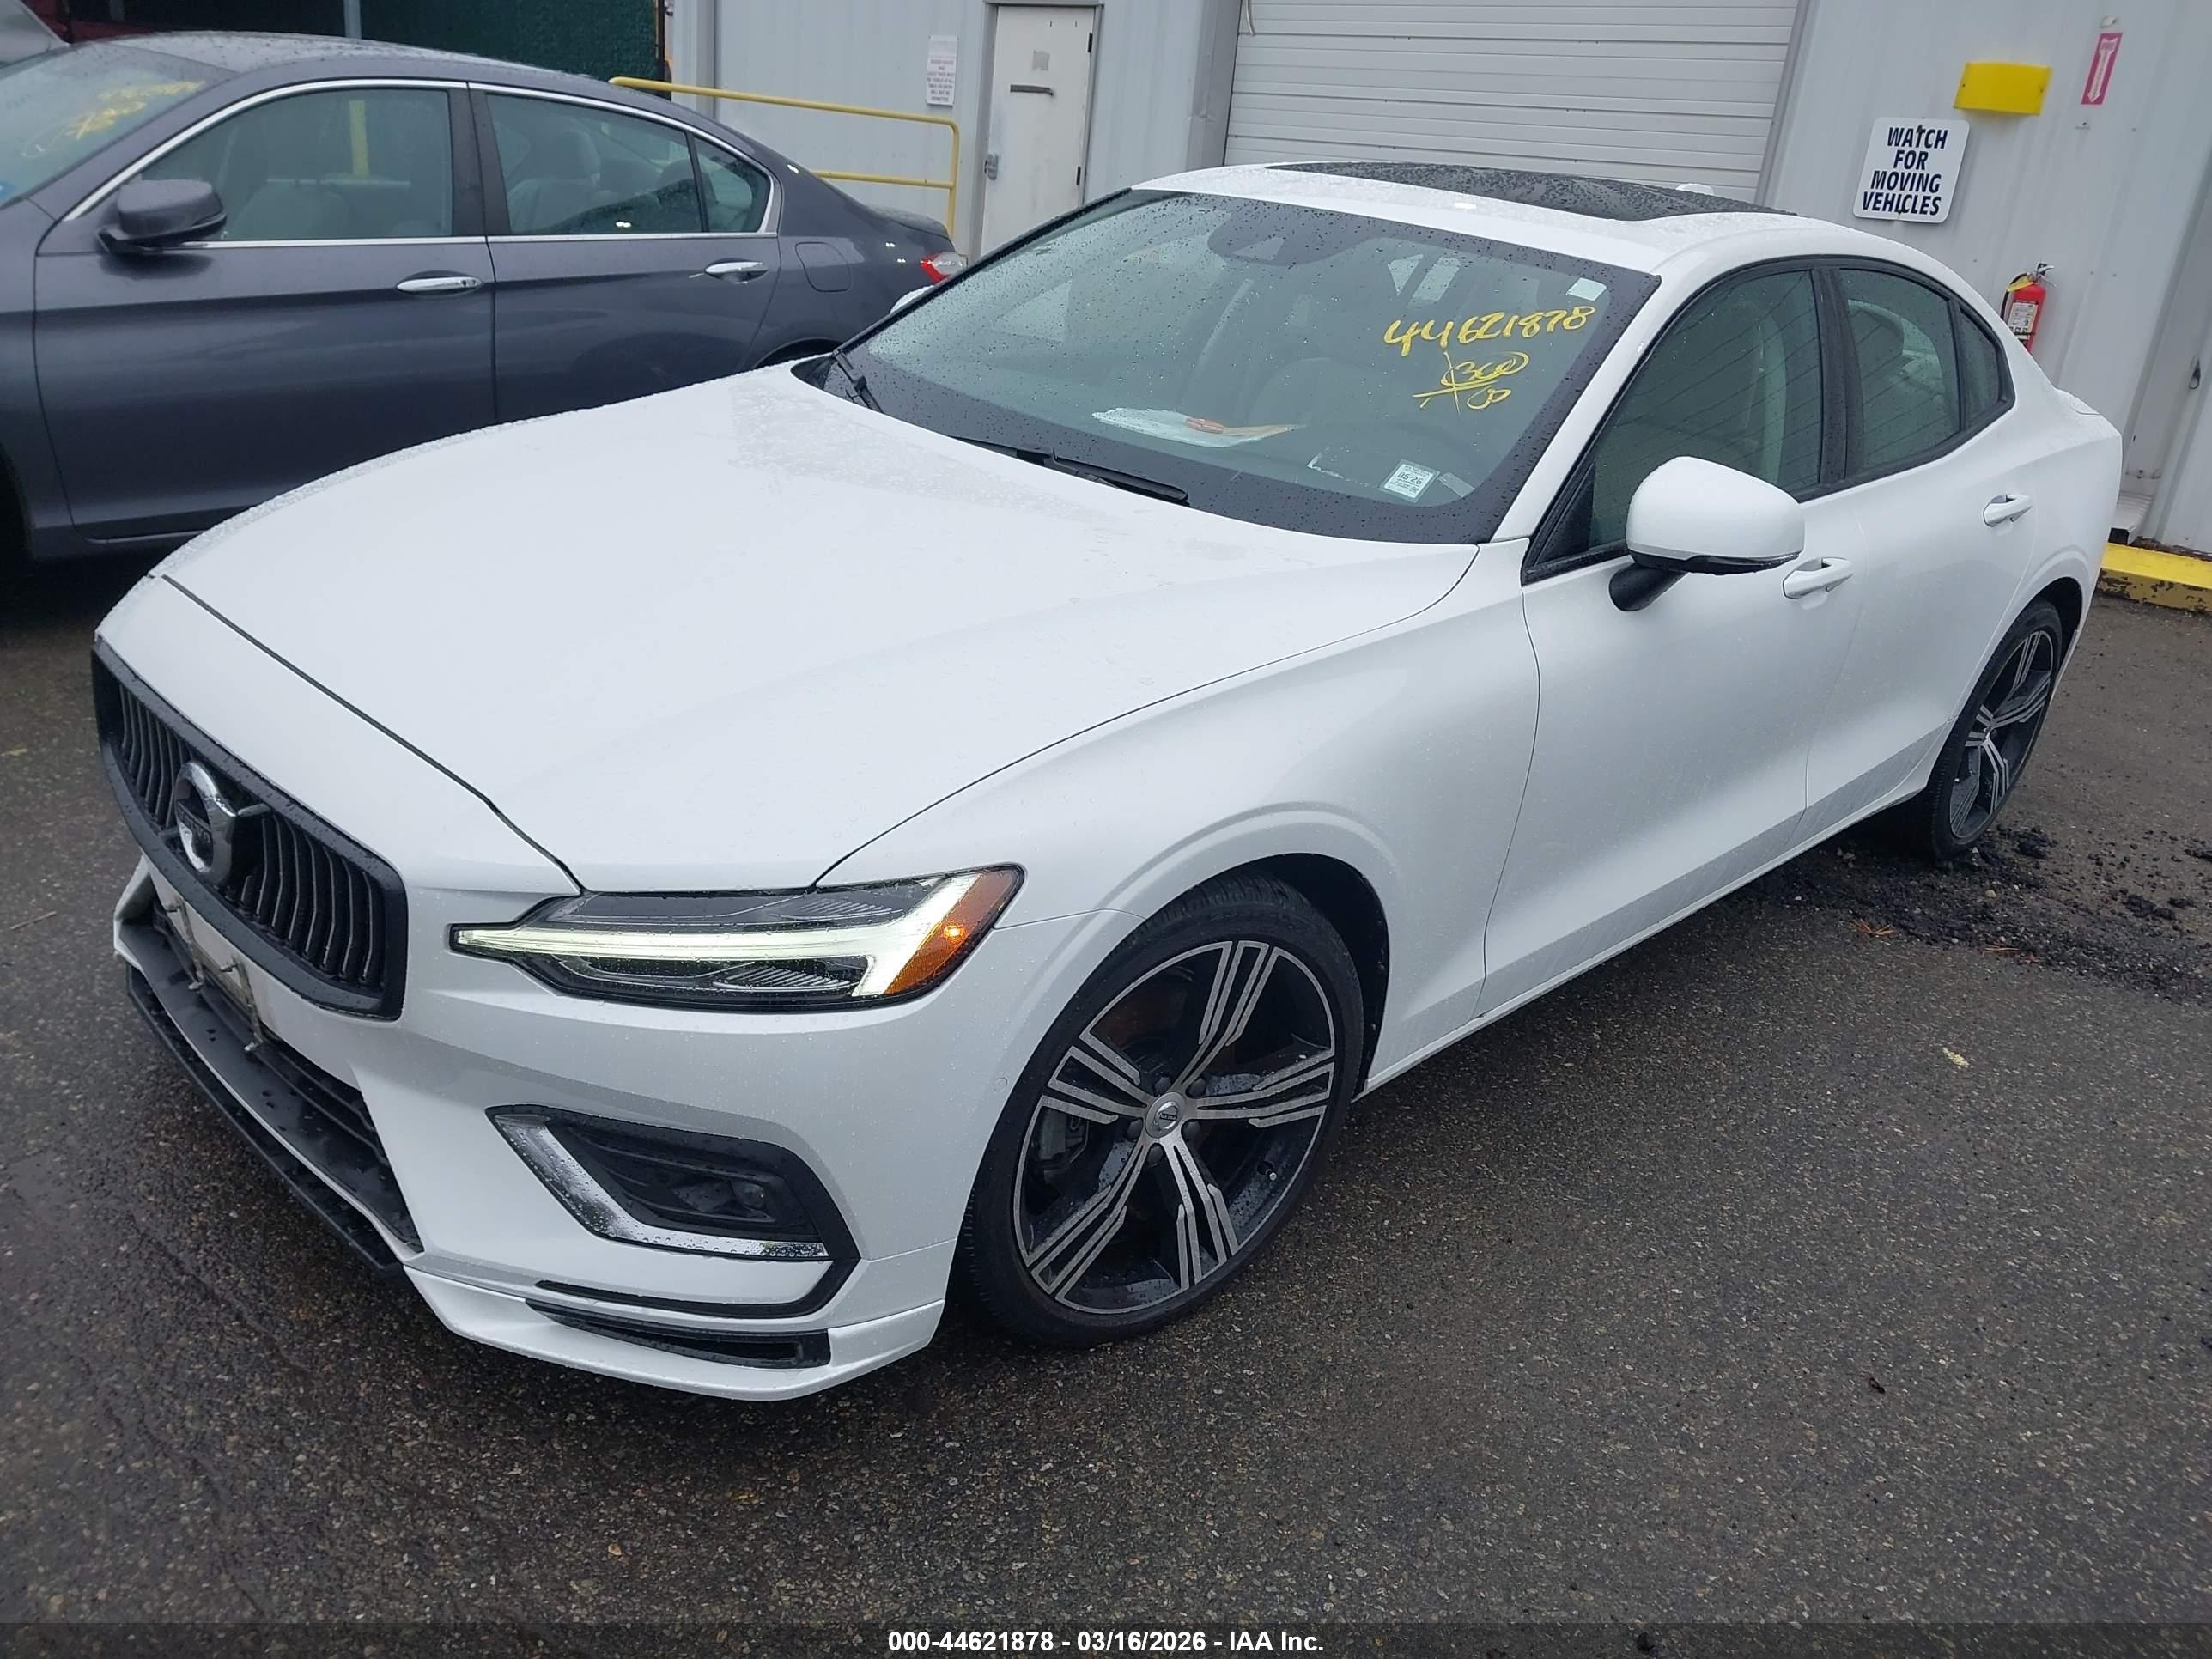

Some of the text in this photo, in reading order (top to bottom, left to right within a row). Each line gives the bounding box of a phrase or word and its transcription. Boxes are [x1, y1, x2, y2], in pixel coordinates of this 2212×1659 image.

[1887, 126, 1948, 149] WATCH
[1893, 149, 1929, 170] FOR
[1870, 170, 1942, 193] MOVING
[1862, 191, 1942, 216] VEHICLES
[1383, 305, 1595, 356] 44621878
